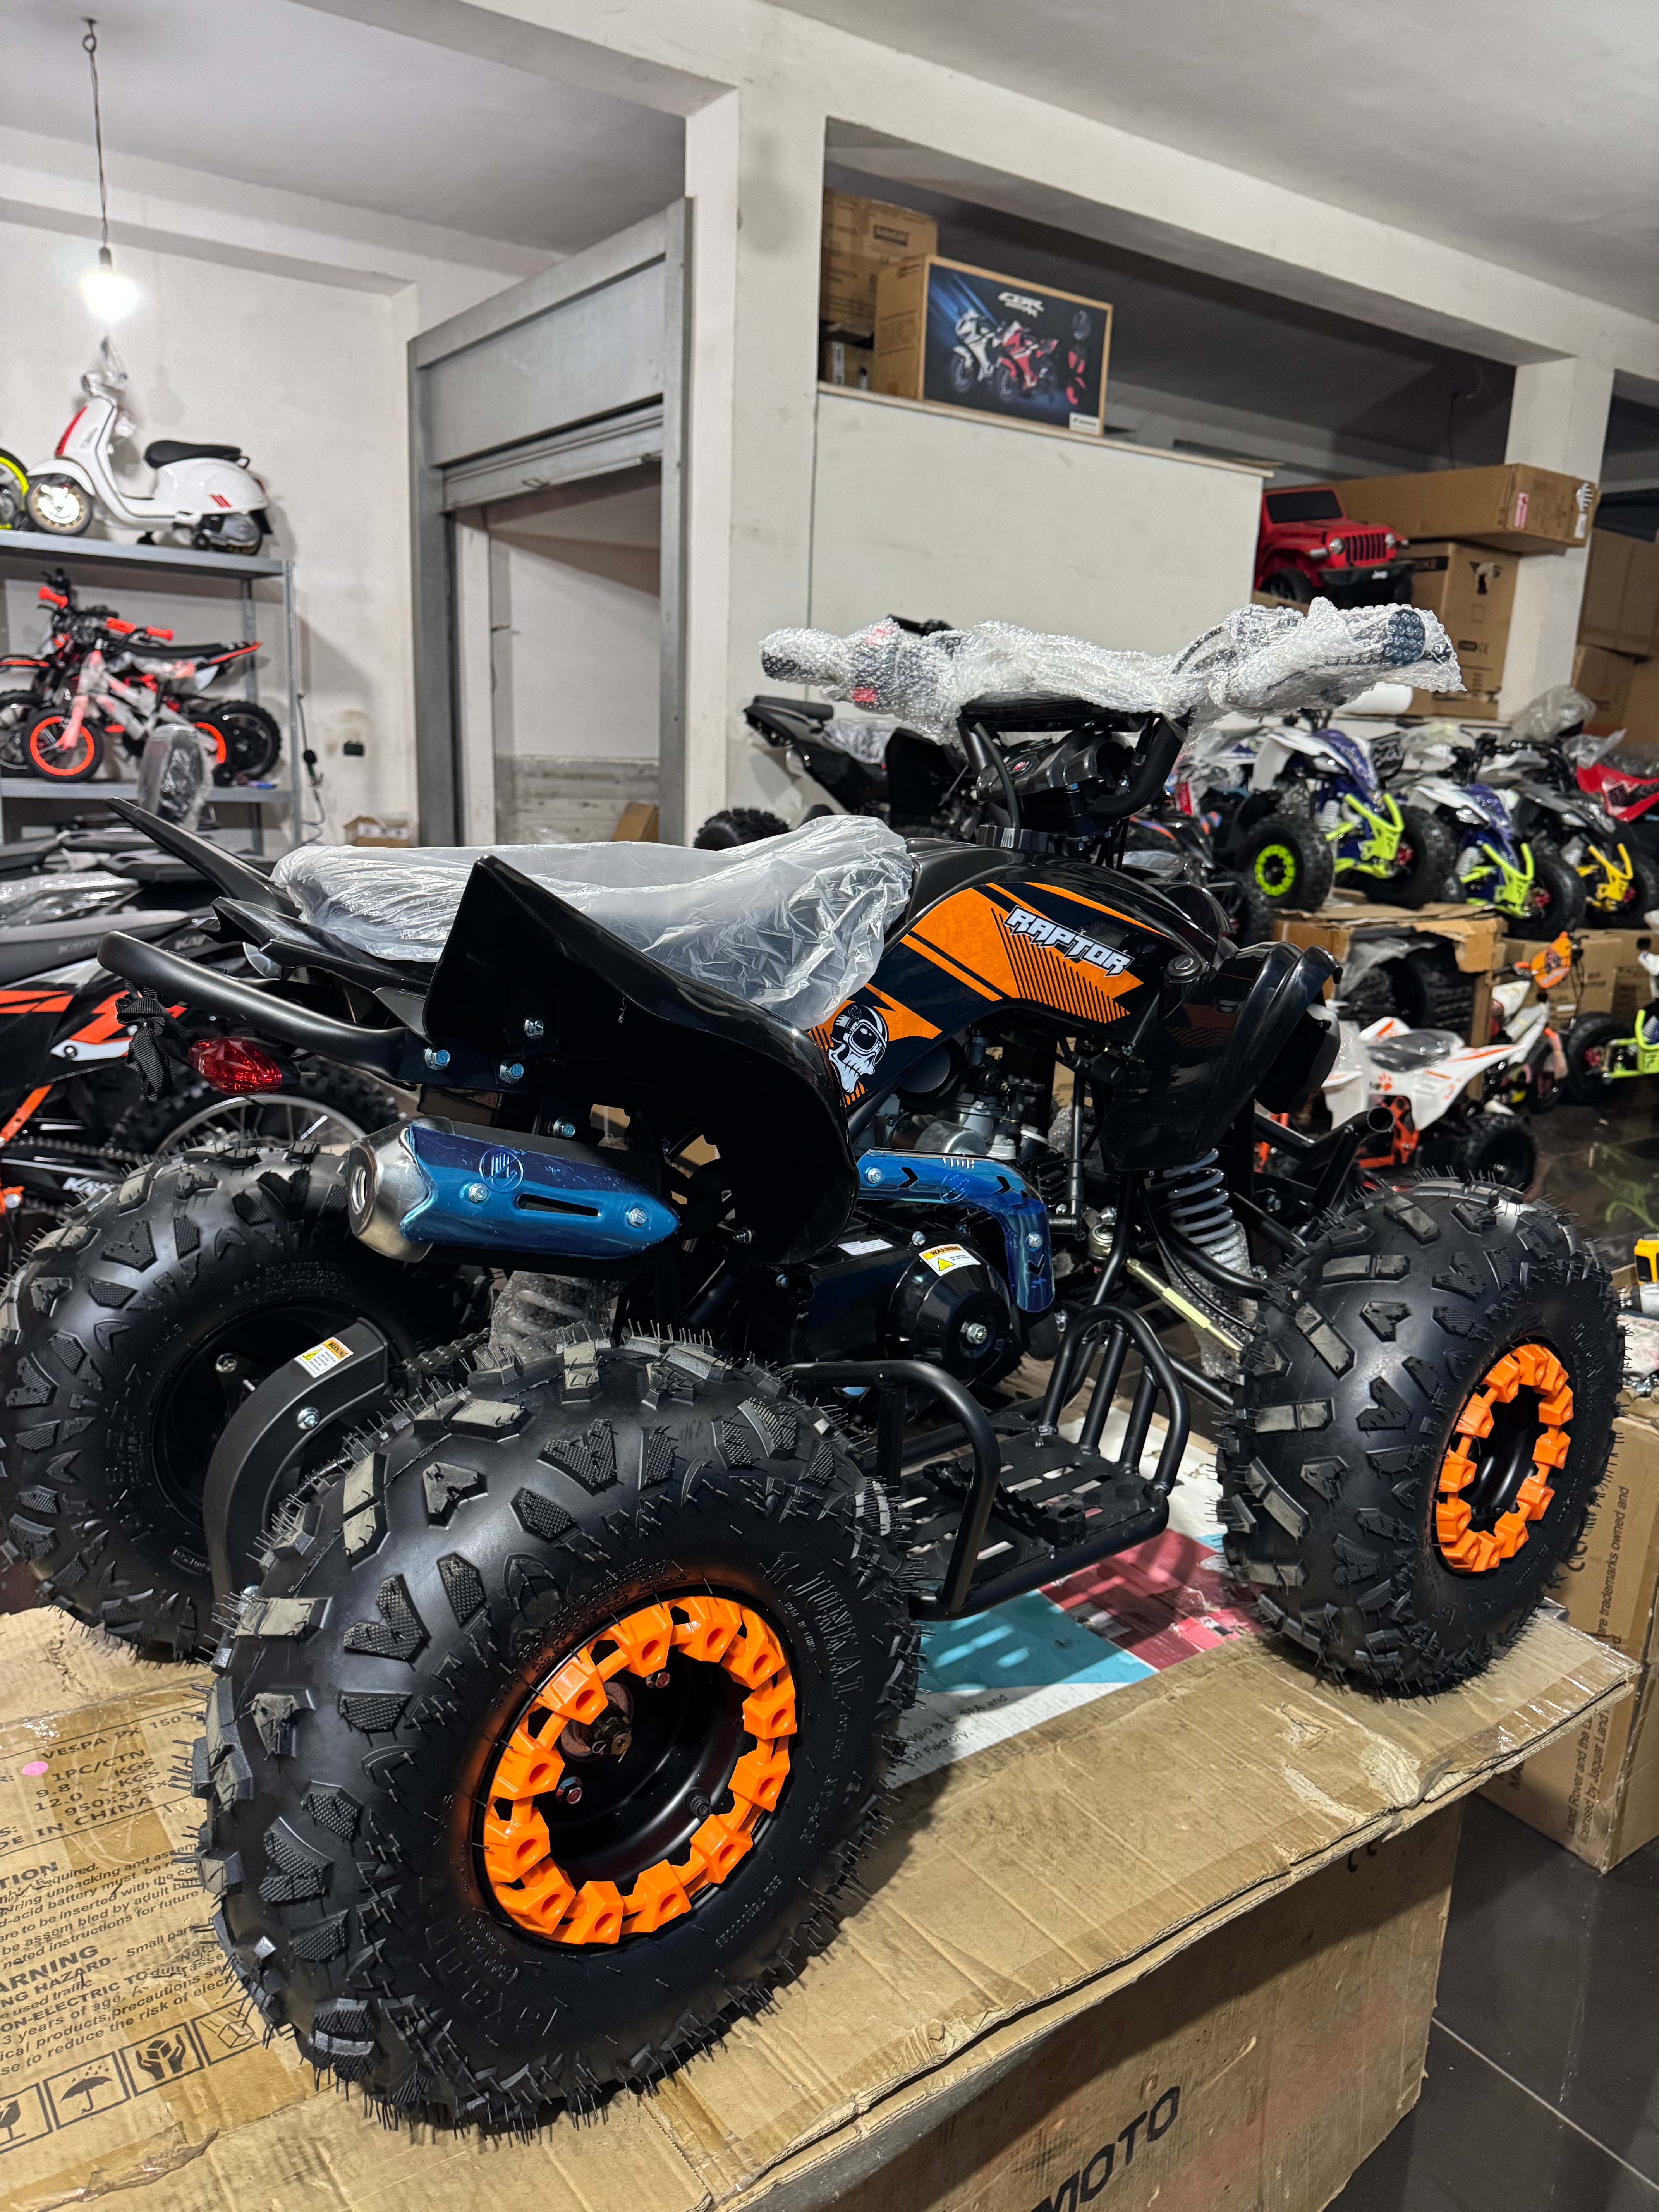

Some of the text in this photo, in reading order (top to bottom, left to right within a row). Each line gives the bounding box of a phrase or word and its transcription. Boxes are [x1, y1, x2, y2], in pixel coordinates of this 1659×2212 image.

[58, 939, 98, 955] KAYO
[175, 934, 211, 950] KAY
[1003, 905, 1134, 977] RAPTOR
[929, 1246, 960, 1256] WARNING
[327, 1341, 349, 1358] WARNING
[1618, 1485, 1630, 1510] and
[1611, 1510, 1626, 1551] owned
[1599, 1551, 1619, 1617] trademarks
[784, 1571, 864, 1699] JUNKAI
[986, 1693, 1008, 1706] and
[41, 1738, 107, 1759] VESPA
[150, 1716, 181, 1729] 150
[36, 1758, 155, 1797] 9.8 KGS
[52, 1749, 145, 1781] 1PC/CTN
[1576, 1749, 1587, 1773] and
[34, 1769, 160, 1811] 12.0 KGS
[36, 1823, 64, 1837] IN
[74, 1796, 153, 1826] CHINA
[47, 1867, 120, 1898] unpacking
[124, 1856, 149, 1871] and
[48, 1887, 97, 1910] battery
[102, 1872, 136, 1891] must
[144, 1865, 161, 1875] be
[2, 1944, 20, 1956] be
[25, 1923, 73, 1947] assem
[78, 1908, 108, 1927] bled
[113, 1901, 130, 1914] by
[134, 1886, 170, 1905] adult
[22, 1924, 36, 1934] to
[40, 1916, 57, 1927] be
[60, 1891, 117, 1920] inserted
[121, 1882, 149, 1897] with
[153, 1873, 174, 1886] the
[49, 1914, 133, 1952] instructions
[136, 1905, 156, 1917] for
[158, 1890, 199, 1909] future
[34, 1956, 118, 1995] HAZARD-
[126, 1935, 163, 1957] Small
[13, 1995, 49, 2016] used
[53, 1980, 92, 2001] traffic
[1, 2063, 21, 2076] se
[26, 2054, 42, 2068] to
[47, 2029, 105, 2058] reduce
[109, 2017, 134, 2033] the
[139, 2001, 169, 2020] risk
[173, 1992, 189, 2005] of
[3, 2035, 12, 2045] 3
[19, 2016, 64, 2044] years
[71, 2006, 87, 2019] of
